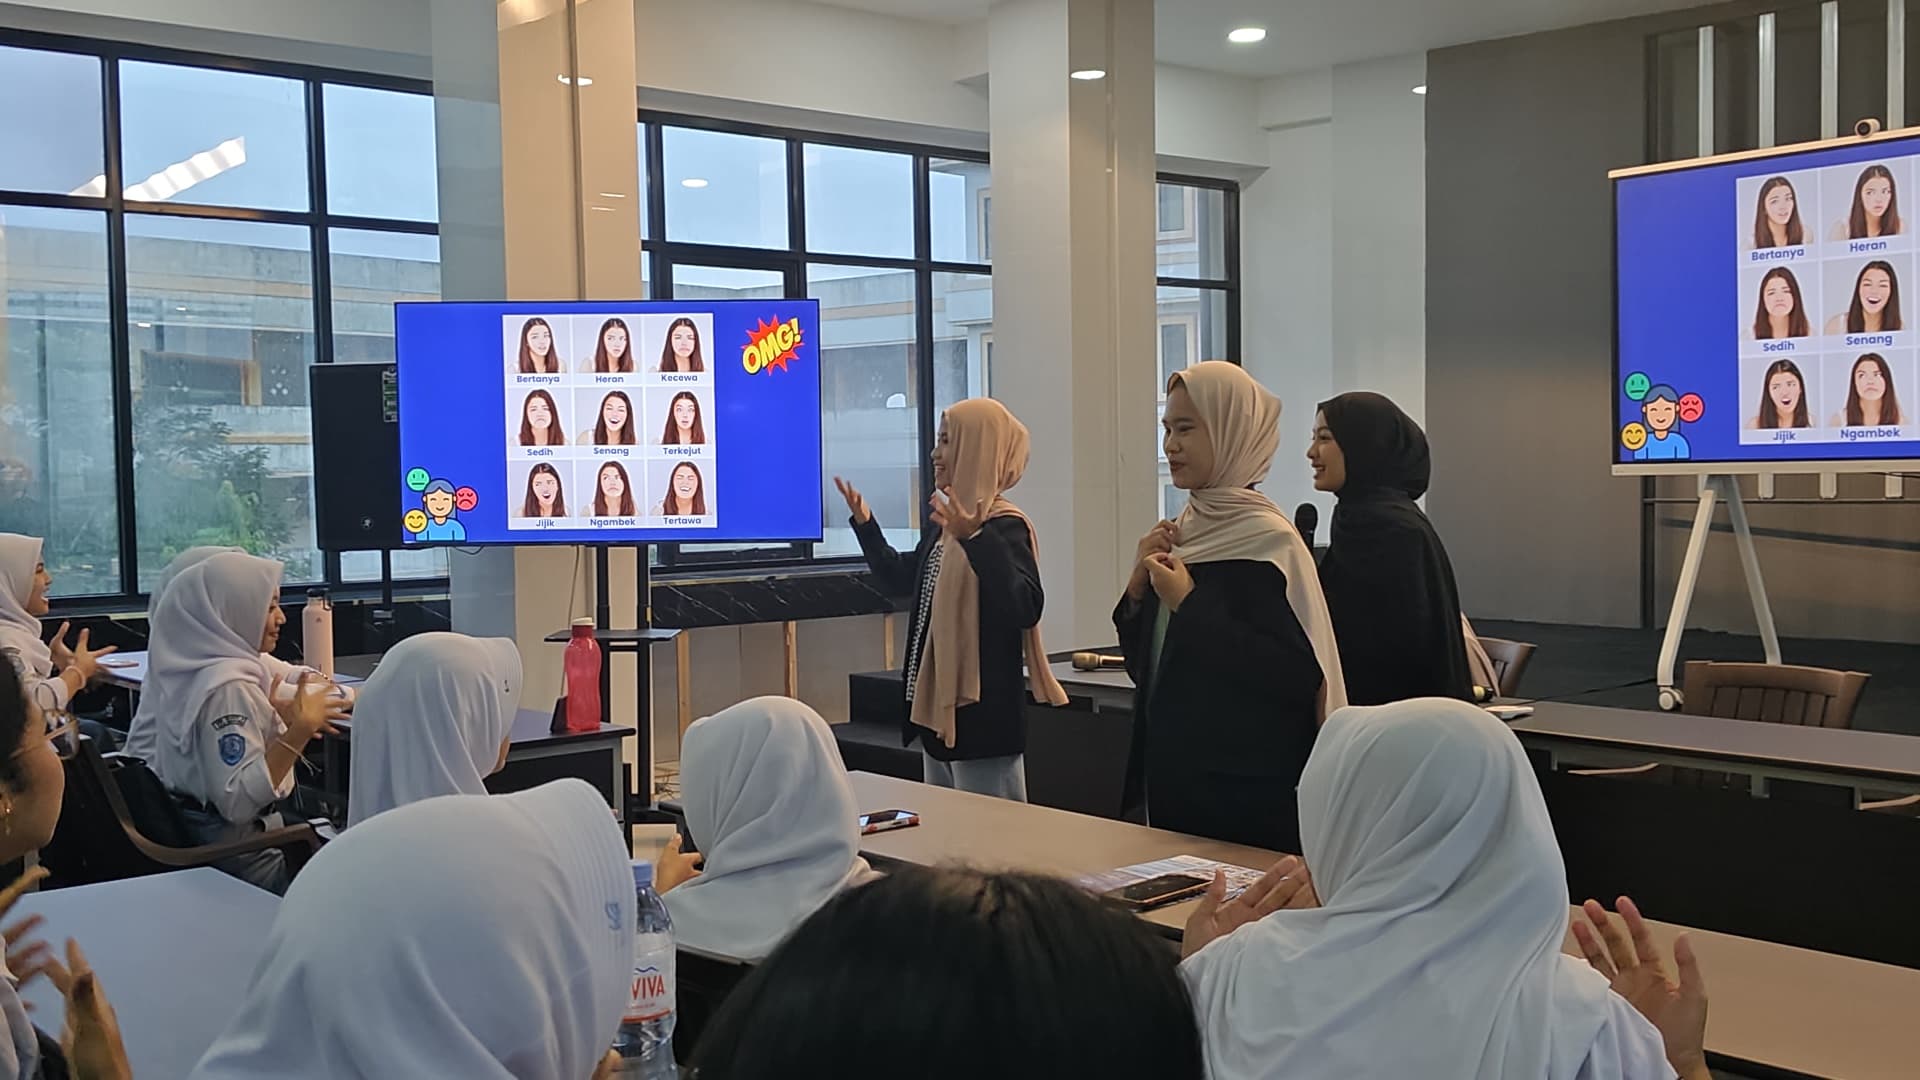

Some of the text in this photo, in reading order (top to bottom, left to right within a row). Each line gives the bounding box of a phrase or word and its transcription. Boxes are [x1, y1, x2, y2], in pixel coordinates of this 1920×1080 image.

[1849, 240, 1887, 253] Heran
[1751, 247, 1805, 261] Bertanya
[1846, 334, 1893, 347] Senang
[742, 317, 801, 375] OMG!
[1762, 340, 1795, 352] Sedih
[516, 374, 560, 384] Bertanya
[595, 374, 624, 383] Heran
[661, 373, 698, 383] Kecewa
[1772, 430, 1796, 444] Jijik
[1840, 427, 1901, 440] Ngambek
[527, 447, 554, 456] Sedih
[593, 447, 629, 456] Senang
[663, 447, 701, 456] Terkejut
[536, 518, 555, 529] Jijik
[590, 518, 636, 528] Ngambek
[663, 517, 702, 526] Tertawa
